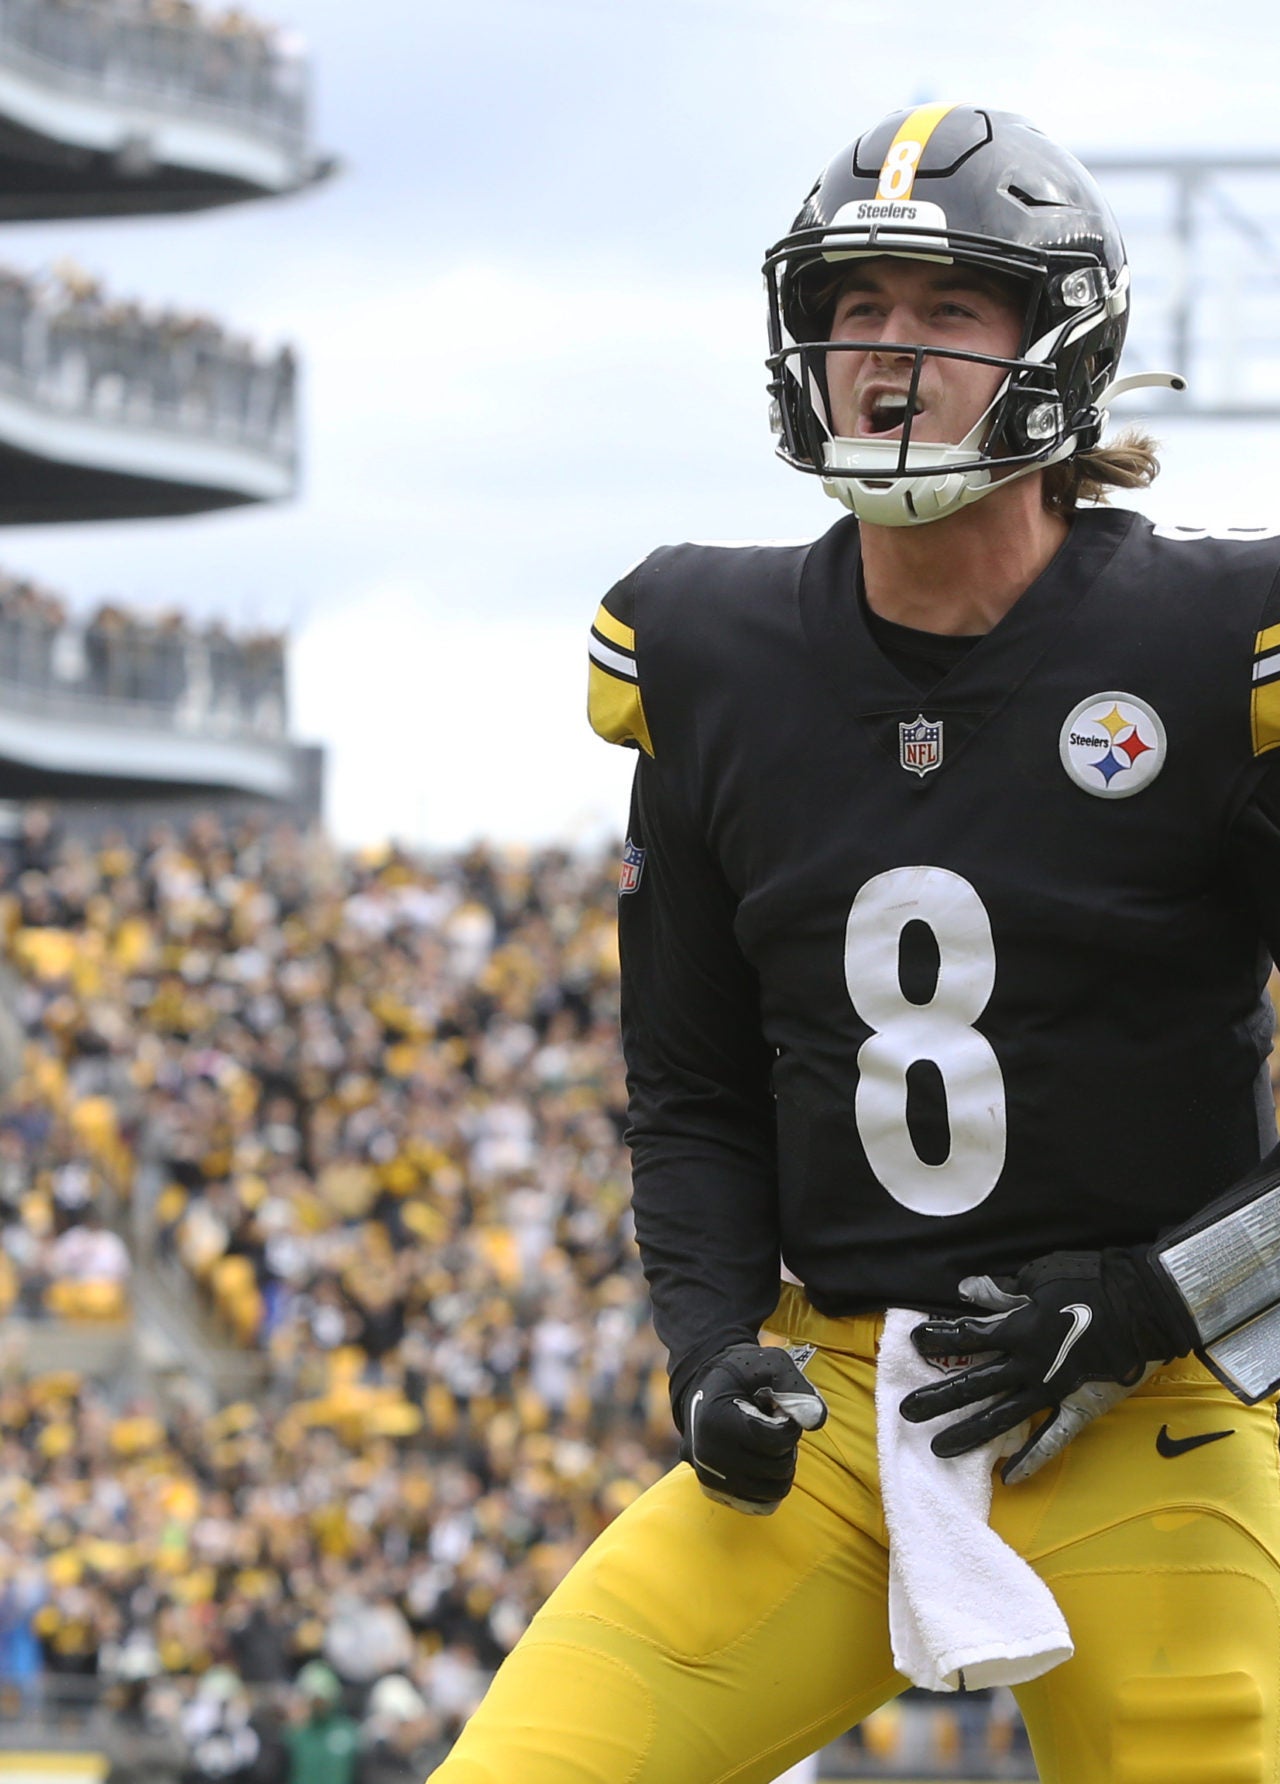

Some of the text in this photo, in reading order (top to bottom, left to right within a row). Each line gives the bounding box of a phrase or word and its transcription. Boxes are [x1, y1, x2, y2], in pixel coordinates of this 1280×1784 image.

[878, 141, 922, 199] 8
[856, 203, 917, 220] Steelers
[1069, 733, 1109, 748] Steelers
[906, 743, 936, 765] NFL
[844, 865, 1008, 1217] 8
